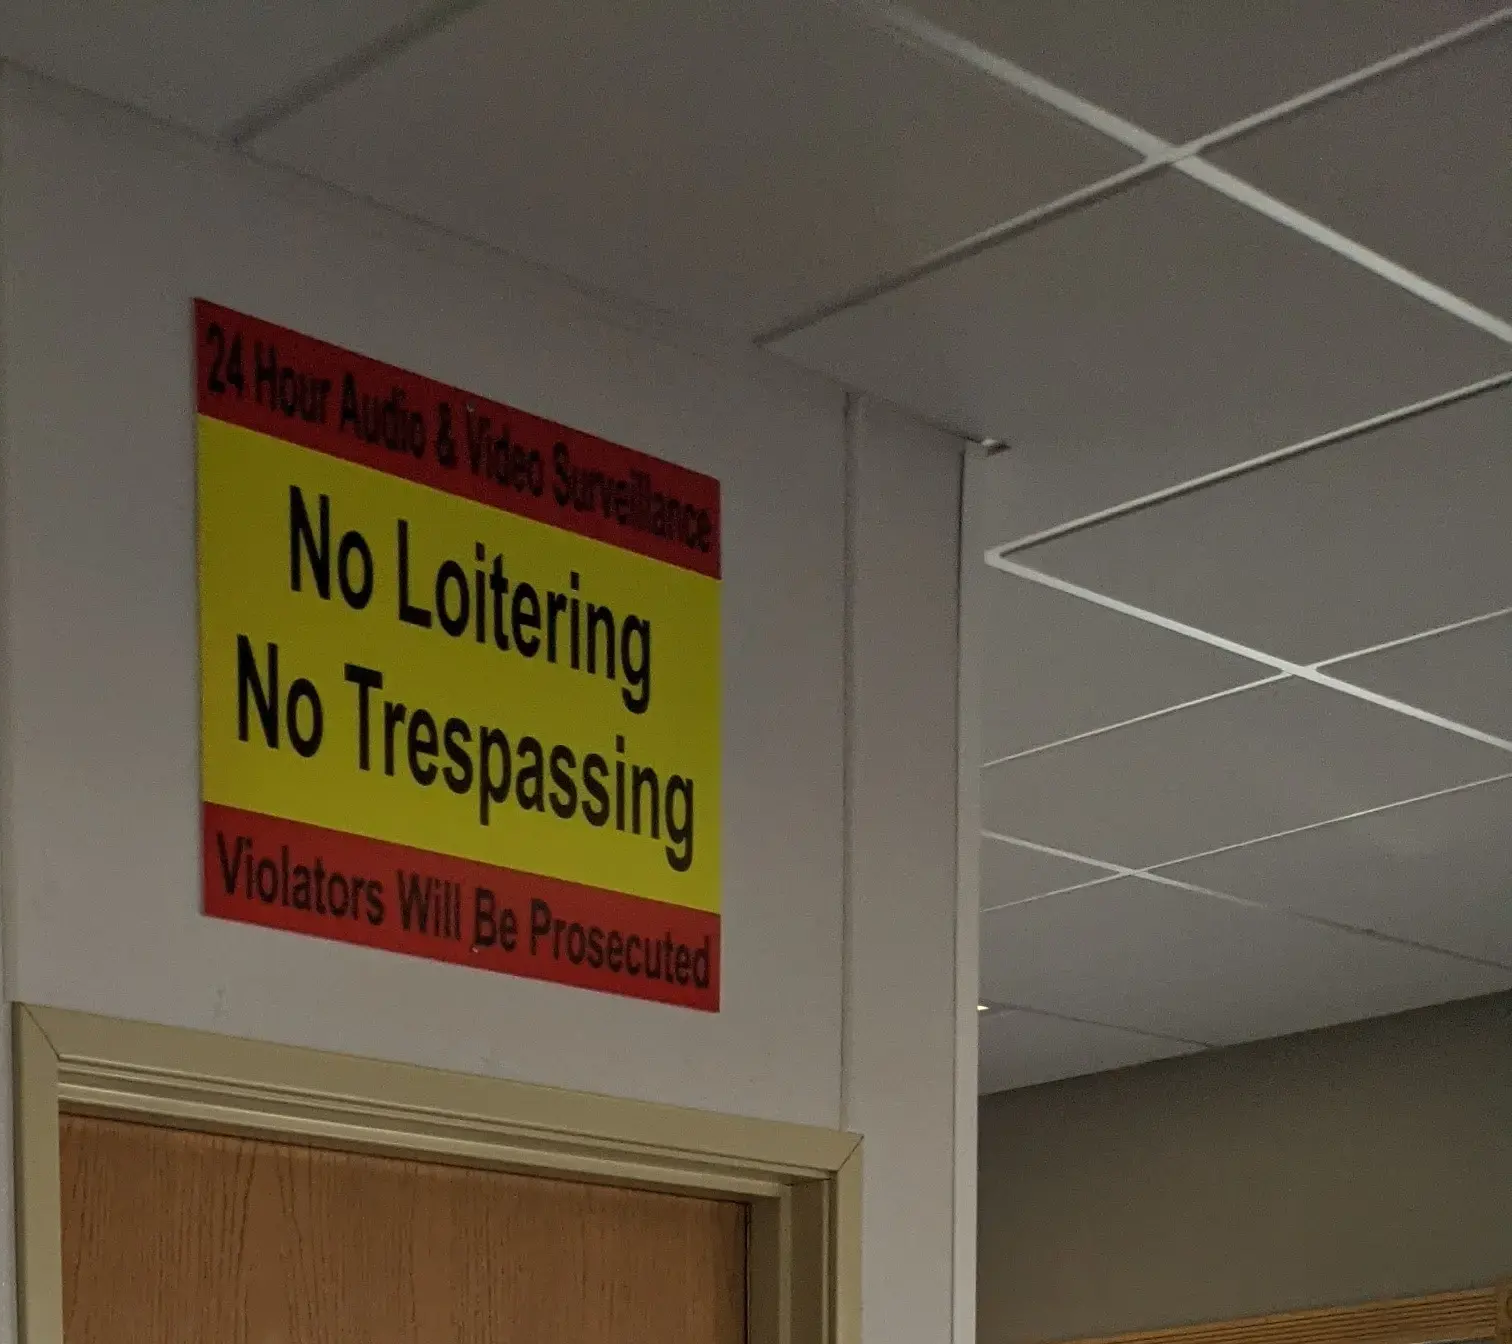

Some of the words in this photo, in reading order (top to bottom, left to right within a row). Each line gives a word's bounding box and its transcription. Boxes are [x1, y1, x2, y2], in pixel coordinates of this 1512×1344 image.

[206, 321, 244, 392] 24
[253, 340, 331, 424] Hour
[340, 371, 426, 459] Audio
[436, 402, 457, 467] &
[466, 403, 543, 498] Video
[552, 440, 710, 553] Surveillance
[289, 484, 374, 610] No
[397, 518, 651, 714] Loitering
[236, 633, 325, 758] No
[343, 662, 694, 873] Trespassing
[216, 830, 386, 926] Violators
[396, 868, 462, 942] Will
[474, 887, 518, 951] Be
[530, 897, 710, 989] Prosecuted
